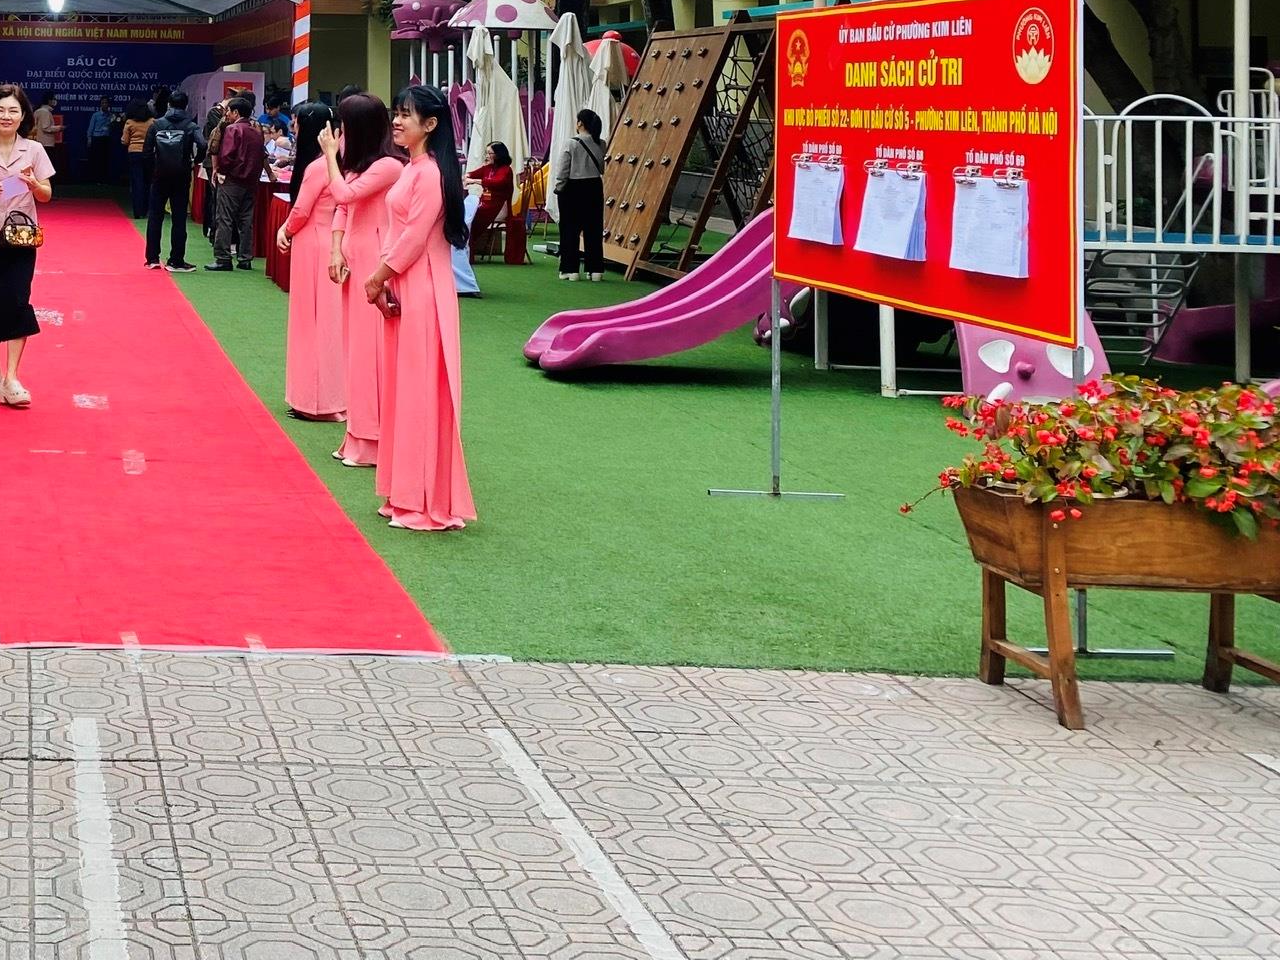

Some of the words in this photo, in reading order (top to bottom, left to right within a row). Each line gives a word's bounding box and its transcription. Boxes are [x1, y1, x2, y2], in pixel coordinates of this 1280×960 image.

[2, 25, 14, 36] XÃ
[17, 26, 32, 38] HỘI
[35, 24, 52, 37] CHỦ
[55, 26, 82, 37] NGHĨA
[86, 26, 104, 39] VIỆT
[106, 29, 127, 38] NAM
[130, 28, 157, 39] MUÔN
[160, 28, 184, 39] NĂM!
[850, 28, 865, 43] BAN
[866, 22, 882, 42] BẦU
[884, 21, 895, 40] CỬ
[896, 20, 930, 40] PHƯỜNG
[932, 20, 949, 37] KIM
[952, 16, 972, 36] LIÊN
[67, 54, 94, 66] BẦU
[98, 55, 117, 67] CỬ
[845, 62, 877, 87] DANH
[880, 55, 914, 87] SÁCH
[918, 48, 938, 87] CỬ
[940, 58, 962, 85] TRI
[68, 69, 92, 79] QUỐC
[95, 70, 111, 80] HỘI
[54, 81, 69, 90] HỘI
[100, 82, 126, 91] NHÂN
[129, 82, 147, 91] DÂN
[915, 106, 944, 130] PHƯỜNG
[945, 111, 959, 131] KIM
[982, 106, 1008, 132] THÀNH
[1009, 104, 1026, 134] PHỐ
[1028, 107, 1040, 134] HÀ
[1042, 107, 1057, 140] NỘI
[965, 148, 974, 163] TỔ
[975, 150, 988, 164] DÂN
[990, 150, 1004, 165] PHỐ
[1005, 151, 1015, 166] SỐ
[1016, 155, 1025, 167] 69
